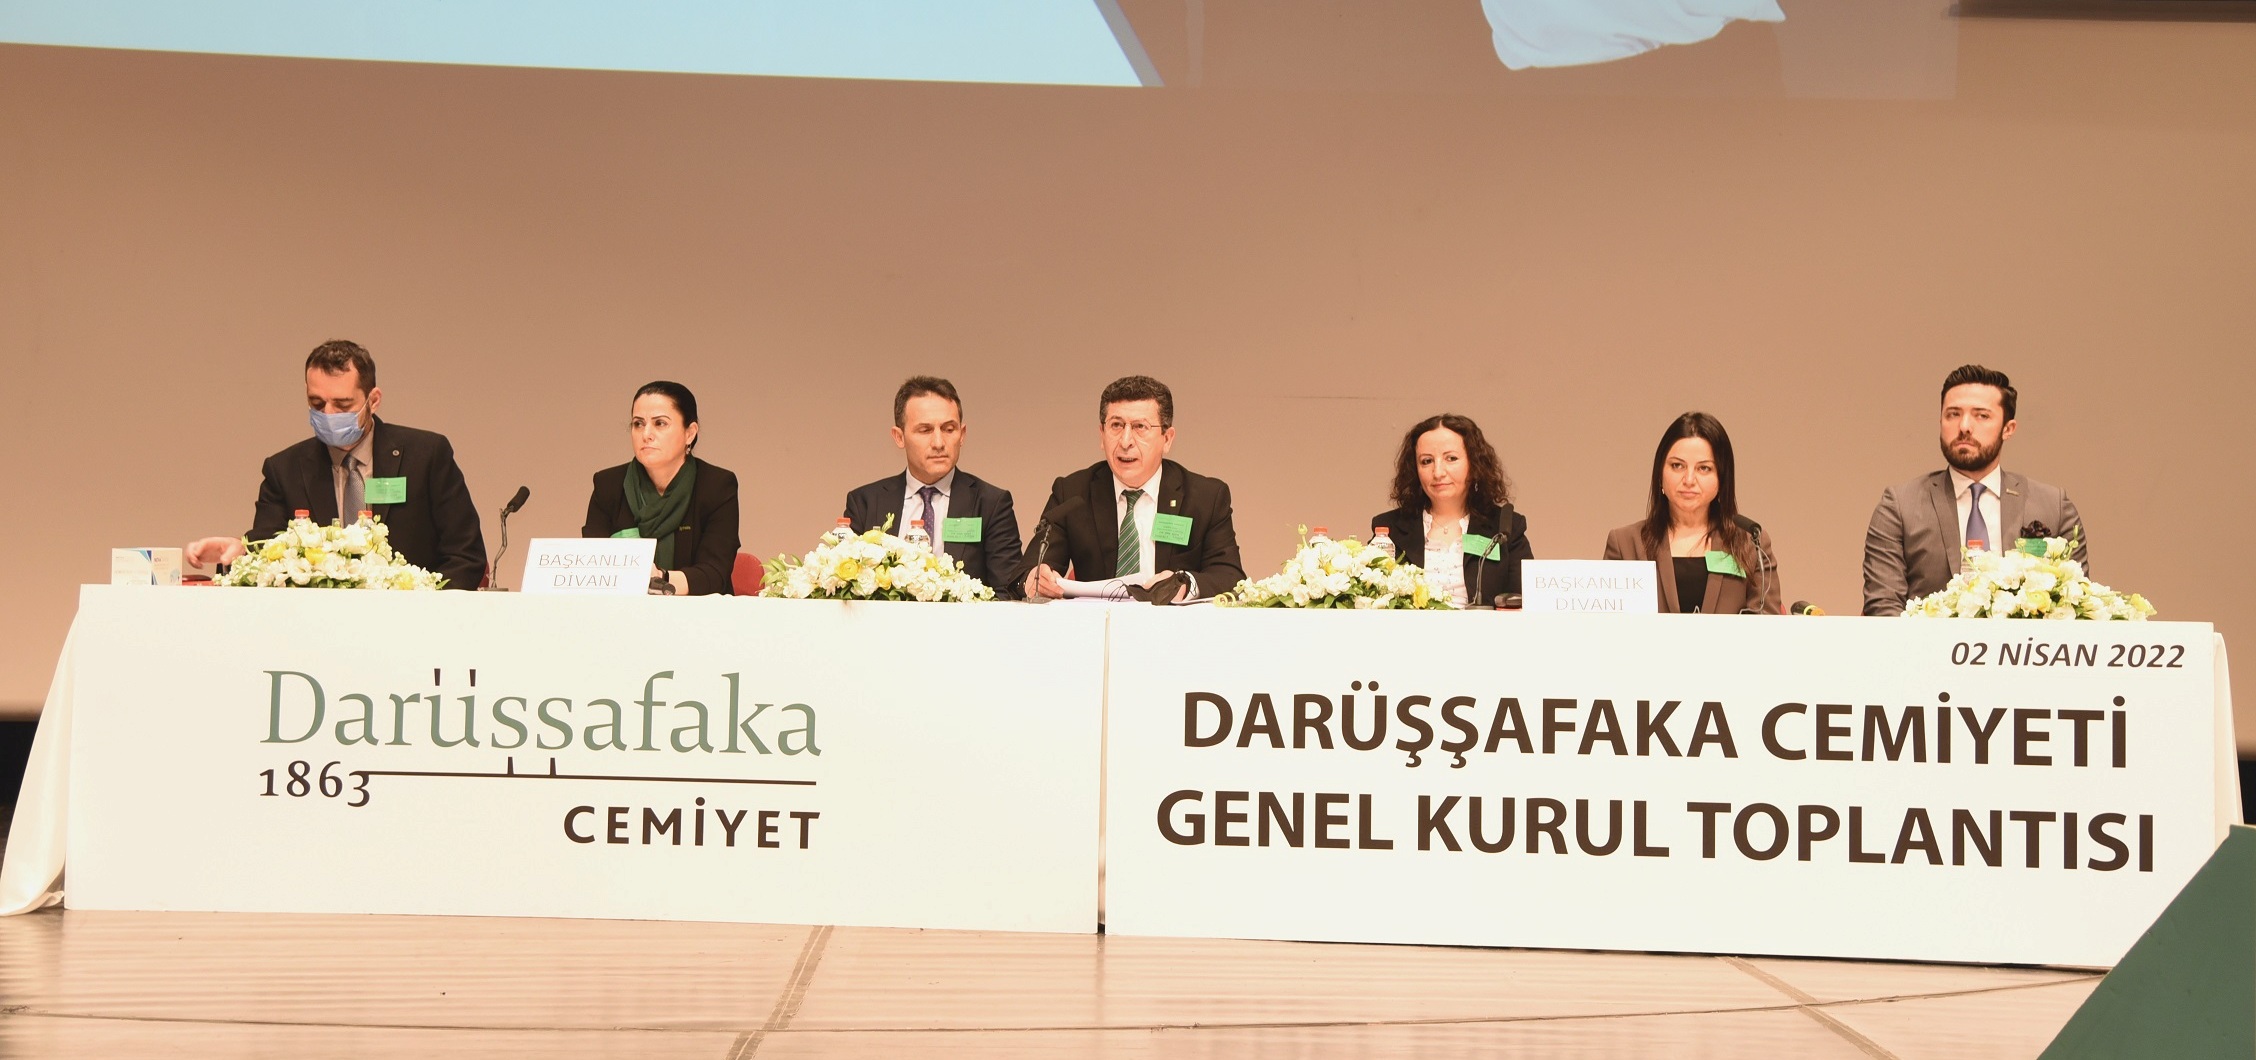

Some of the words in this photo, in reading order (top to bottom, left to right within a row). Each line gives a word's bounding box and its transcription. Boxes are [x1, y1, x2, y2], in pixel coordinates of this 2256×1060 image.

[538, 553, 641, 569] BAŞKANLIK
[553, 572, 619, 587] DİVANI
[1534, 576, 1645, 591] BAŞKANLIK
[1951, 642, 1988, 666] 02
[1998, 636, 2099, 667] NİSAN
[2106, 644, 2185, 668] 2022
[1184, 680, 1739, 769] DARÜŞŞAFAKA
[1761, 691, 2127, 769] CEMİYETİ
[258, 759, 371, 808] 1863
[563, 796, 821, 850] CEMİYET
[1156, 789, 1394, 851] GENEL
[1417, 794, 1670, 858] KURUL
[1686, 801, 2155, 873] TOPLANTISI
